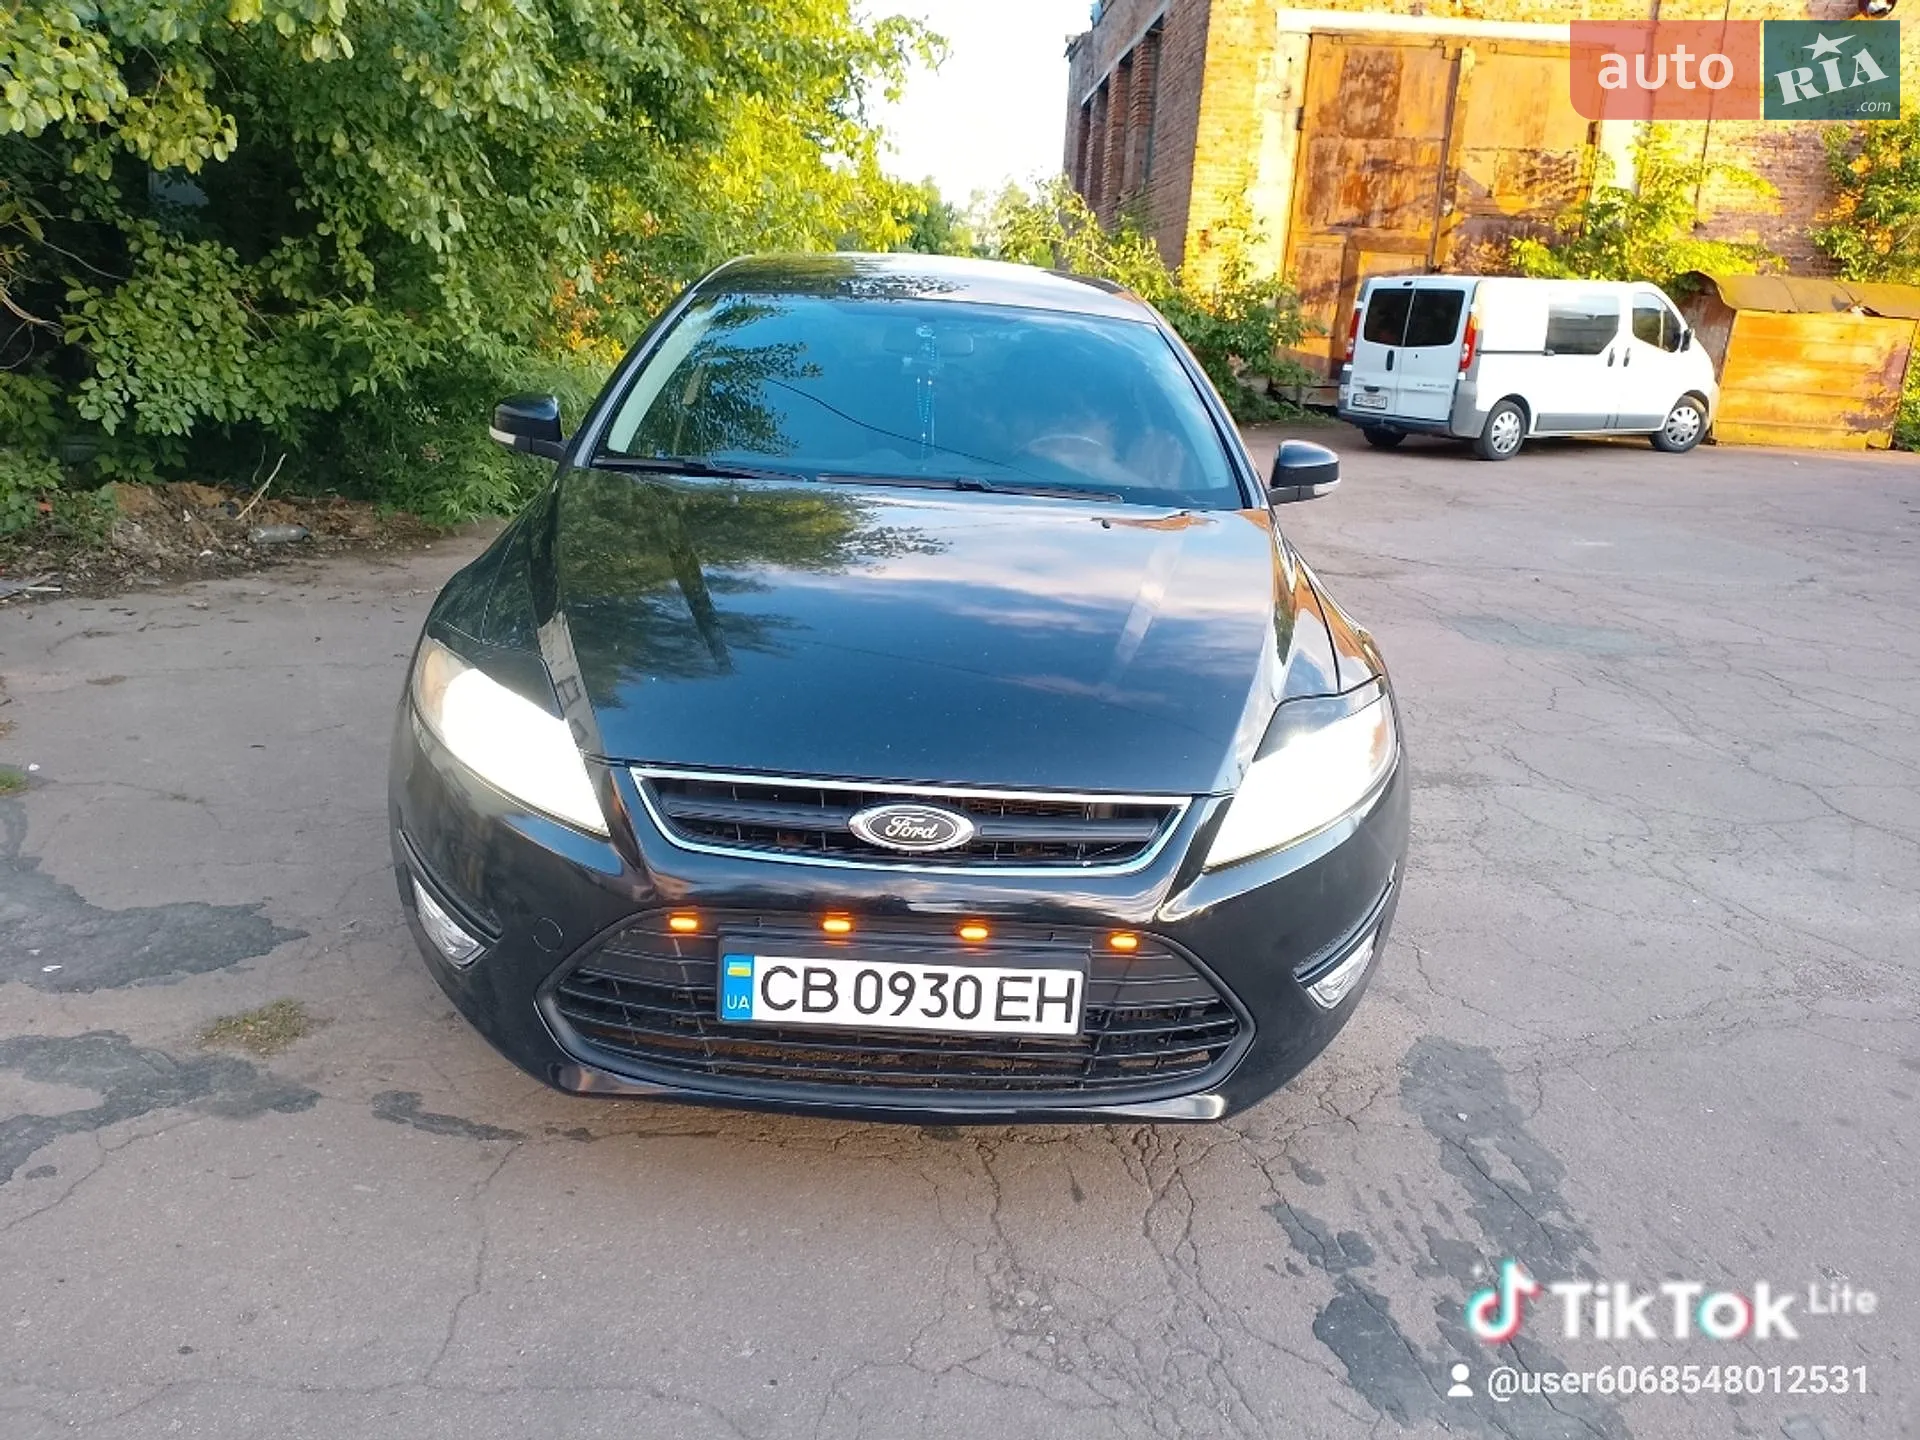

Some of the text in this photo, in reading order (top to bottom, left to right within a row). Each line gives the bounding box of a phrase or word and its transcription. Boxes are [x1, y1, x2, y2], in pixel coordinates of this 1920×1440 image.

[885, 815, 938, 840] Ford
[726, 995, 750, 1009] UA
[761, 966, 1075, 1023] CB 0930 EH
